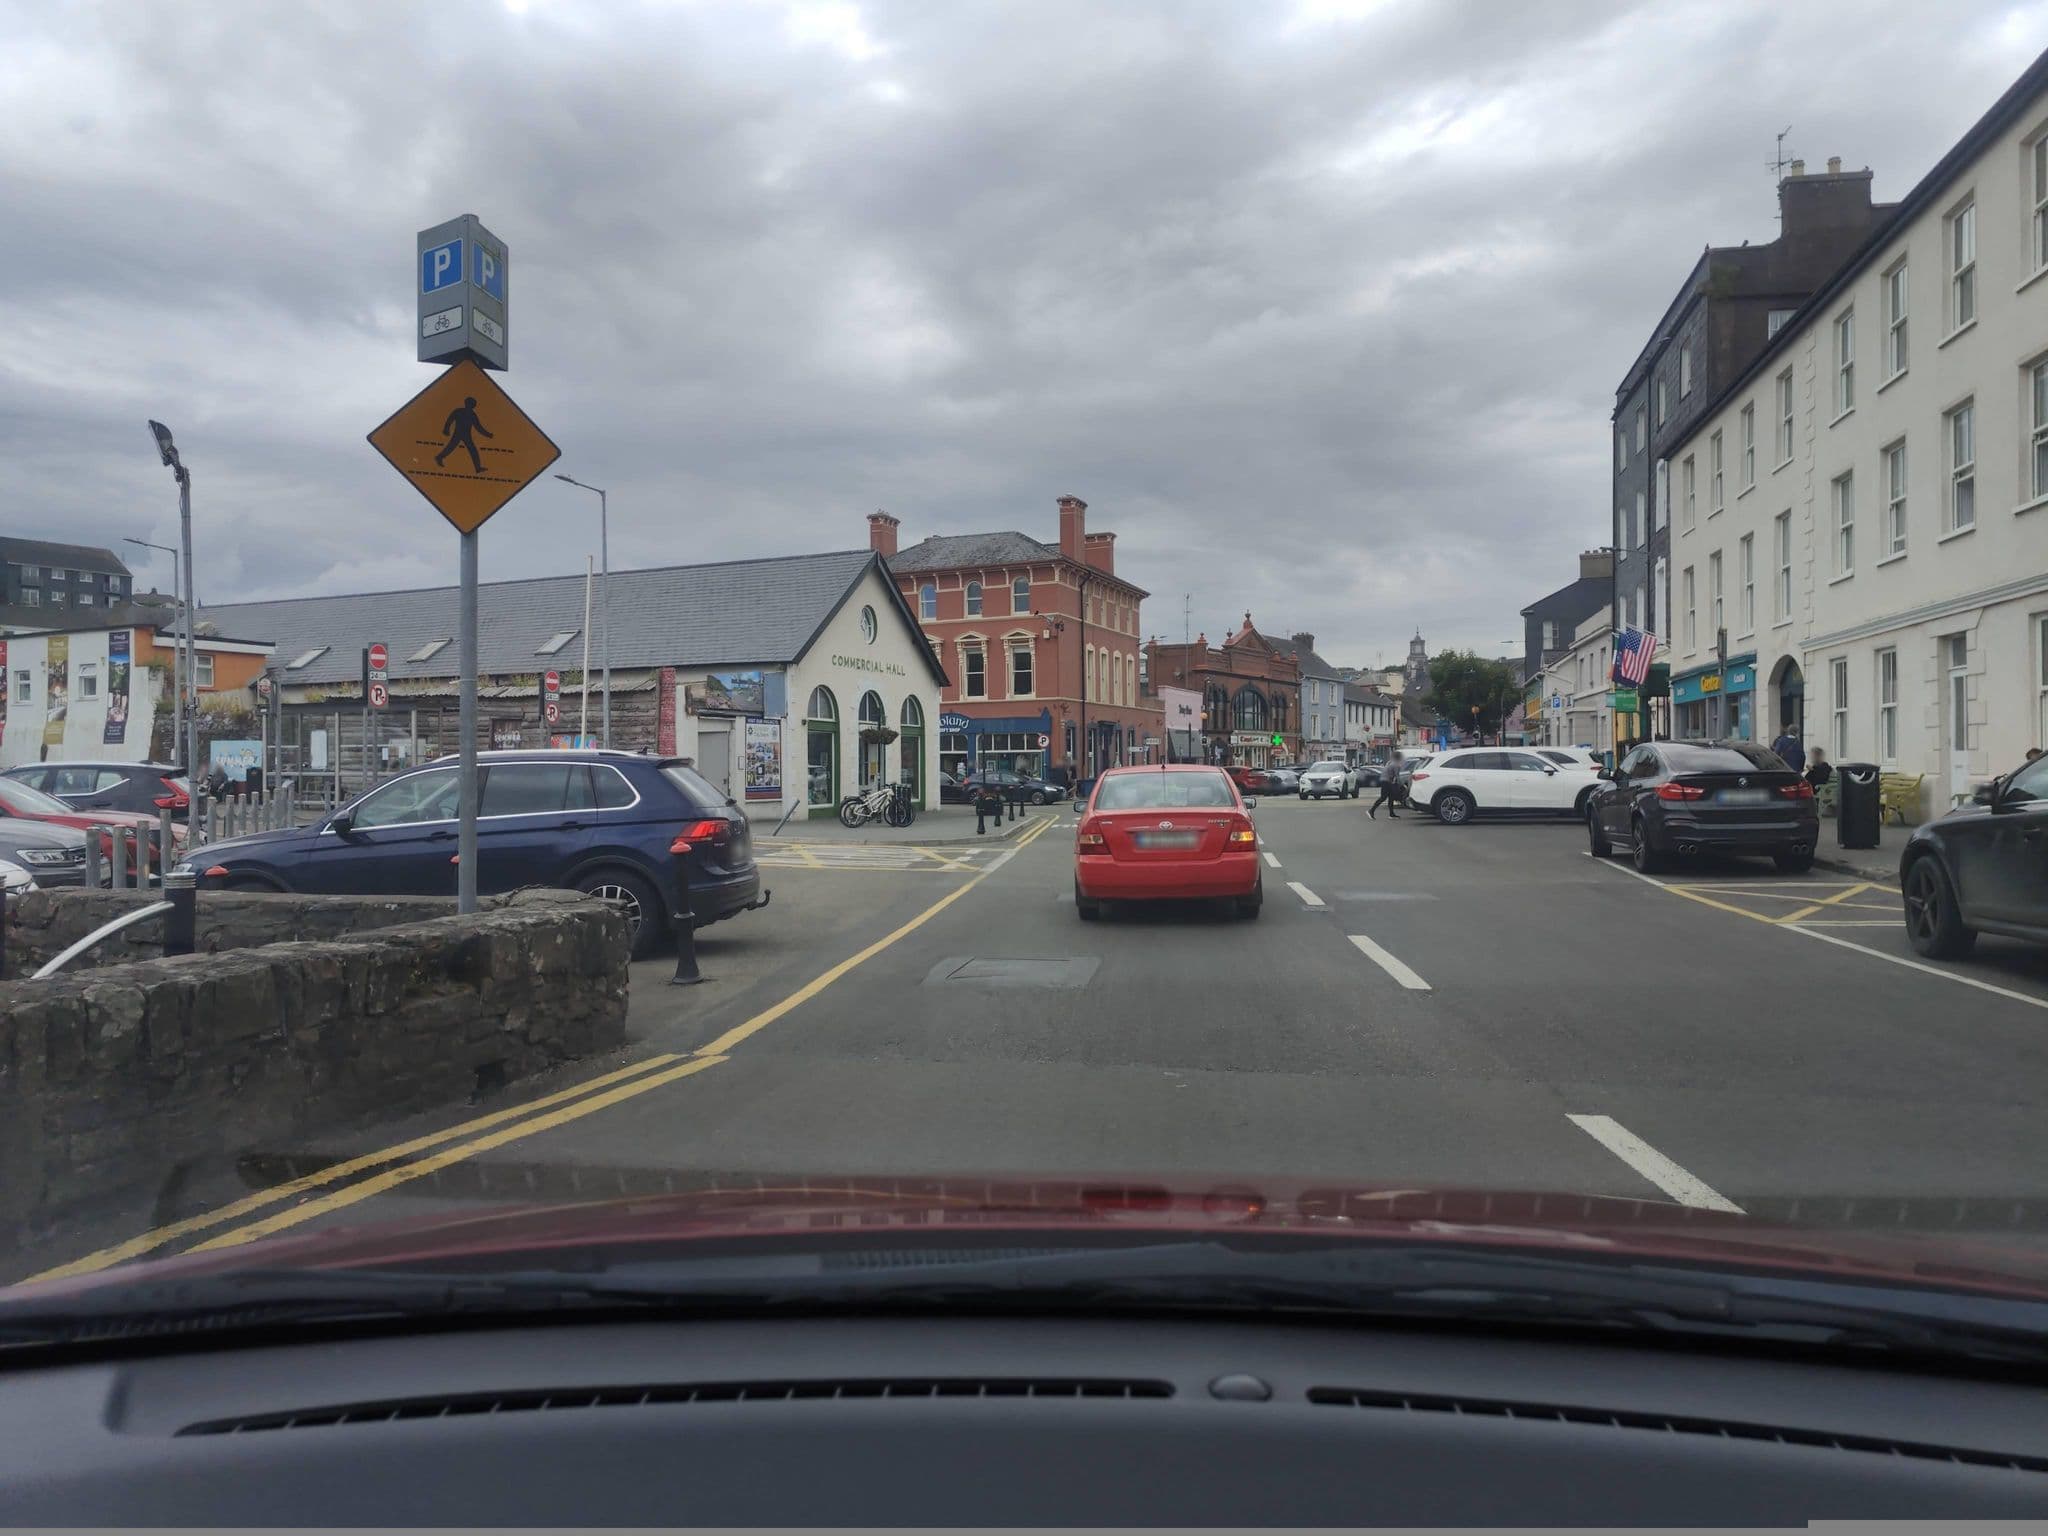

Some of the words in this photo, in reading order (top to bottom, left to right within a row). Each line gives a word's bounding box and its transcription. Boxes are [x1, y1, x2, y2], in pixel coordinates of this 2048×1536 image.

[434, 248, 451, 287] P
[481, 251, 495, 287] P
[831, 654, 884, 673] COMMERCIAL
[886, 662, 906, 677] HALL
[375, 687, 383, 702] P
